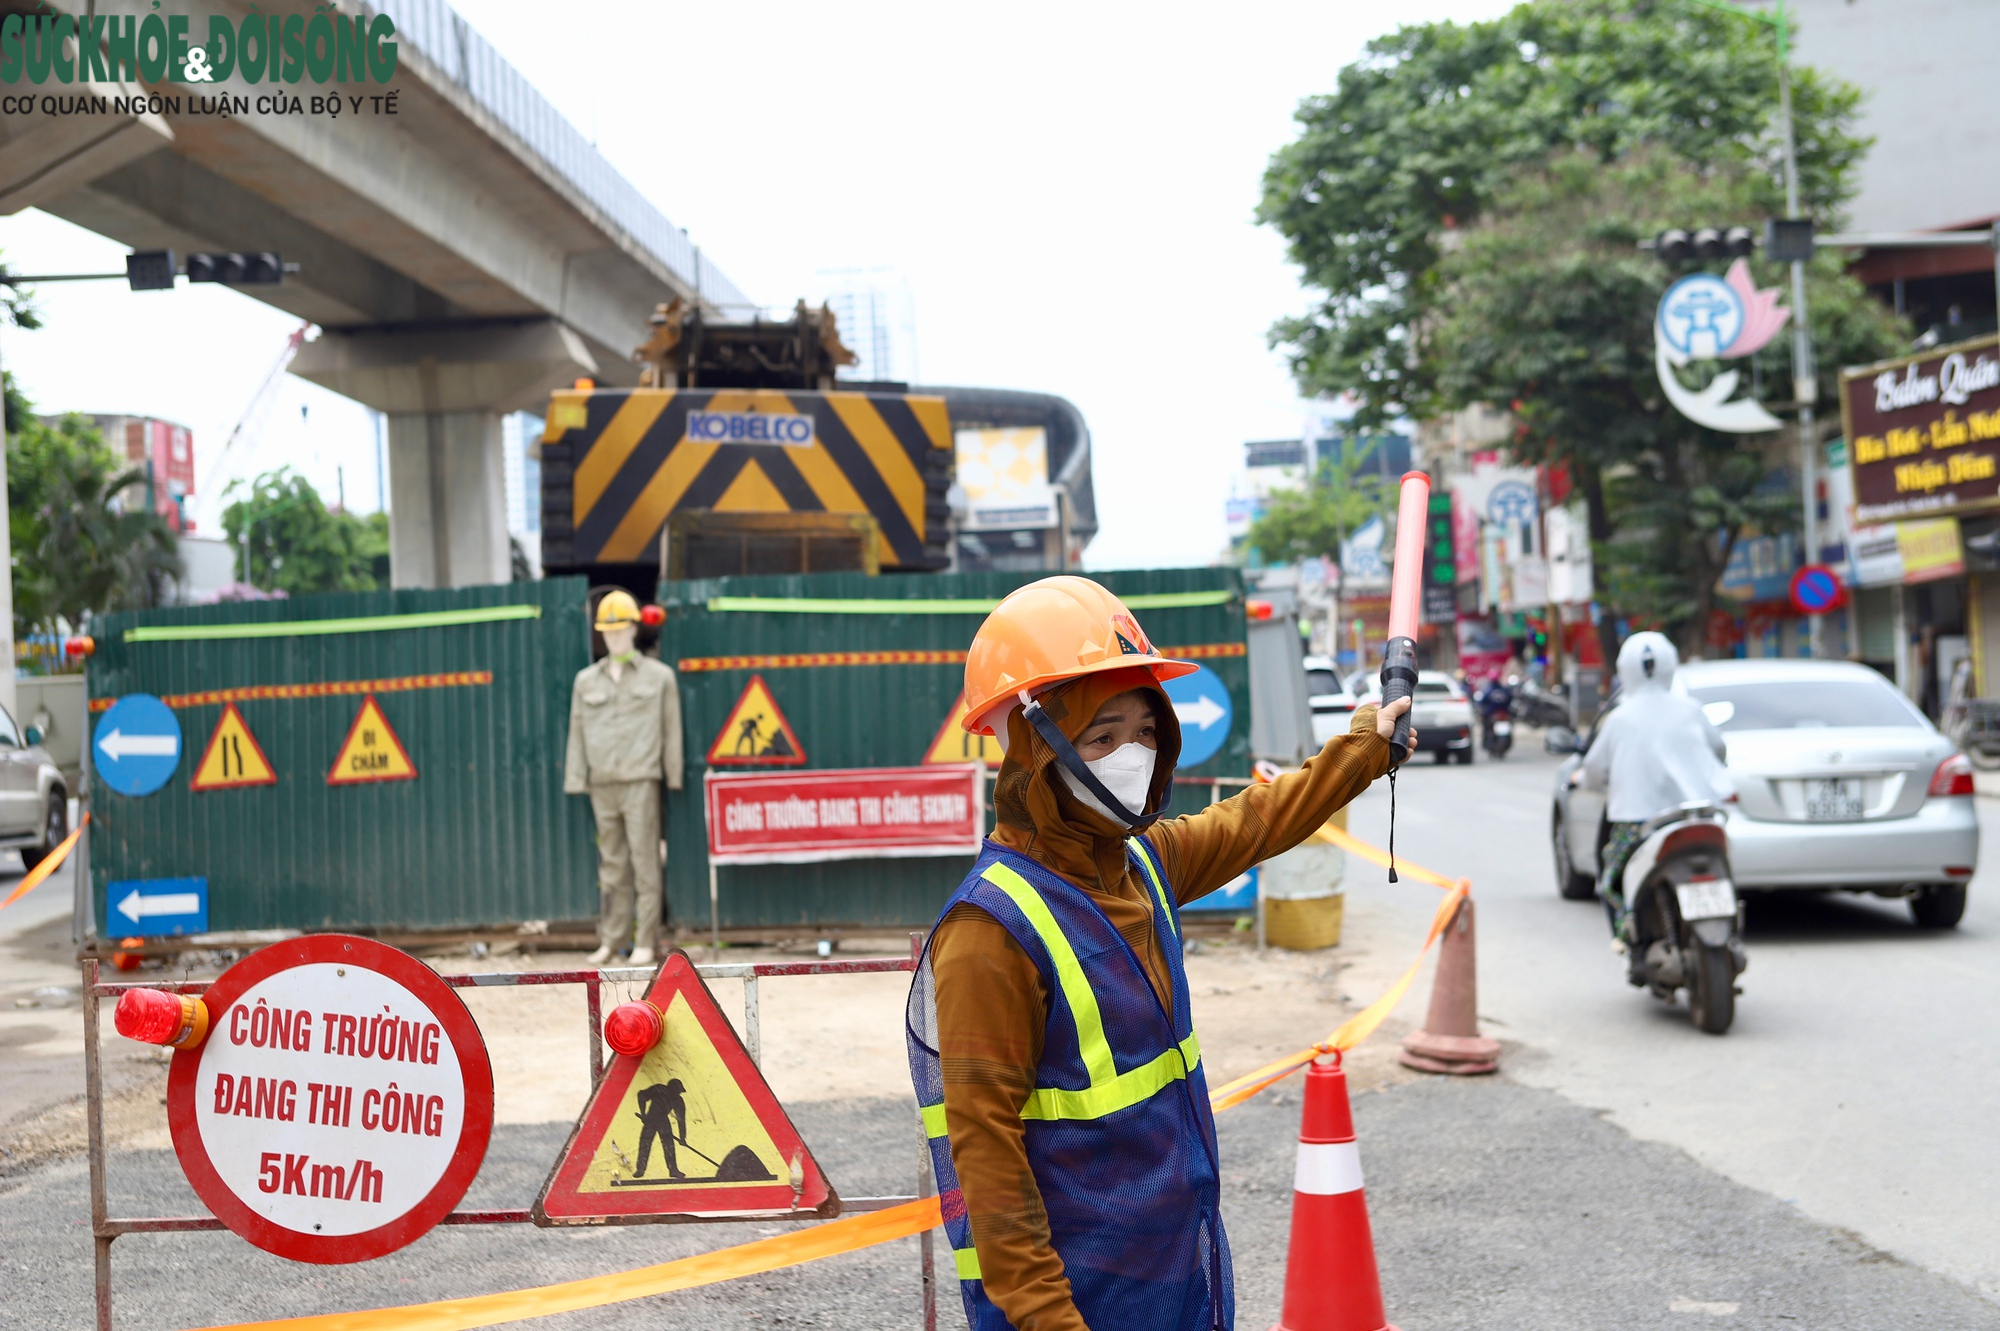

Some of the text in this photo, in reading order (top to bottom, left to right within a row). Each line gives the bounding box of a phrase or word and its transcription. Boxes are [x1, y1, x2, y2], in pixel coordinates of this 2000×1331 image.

[689, 414, 811, 443] KOBELCO
[725, 798, 764, 832] CÔNG
[764, 794, 819, 830] TRƯỜNG
[819, 797, 858, 827] ĐANG
[859, 796, 882, 825] THI
[882, 791, 922, 825] CÔNG
[229, 997, 440, 1065] CÔNG TRƯỜNG
[213, 1073, 444, 1137] ĐANG THI CÔNG
[257, 1151, 384, 1203] 5Km/h
